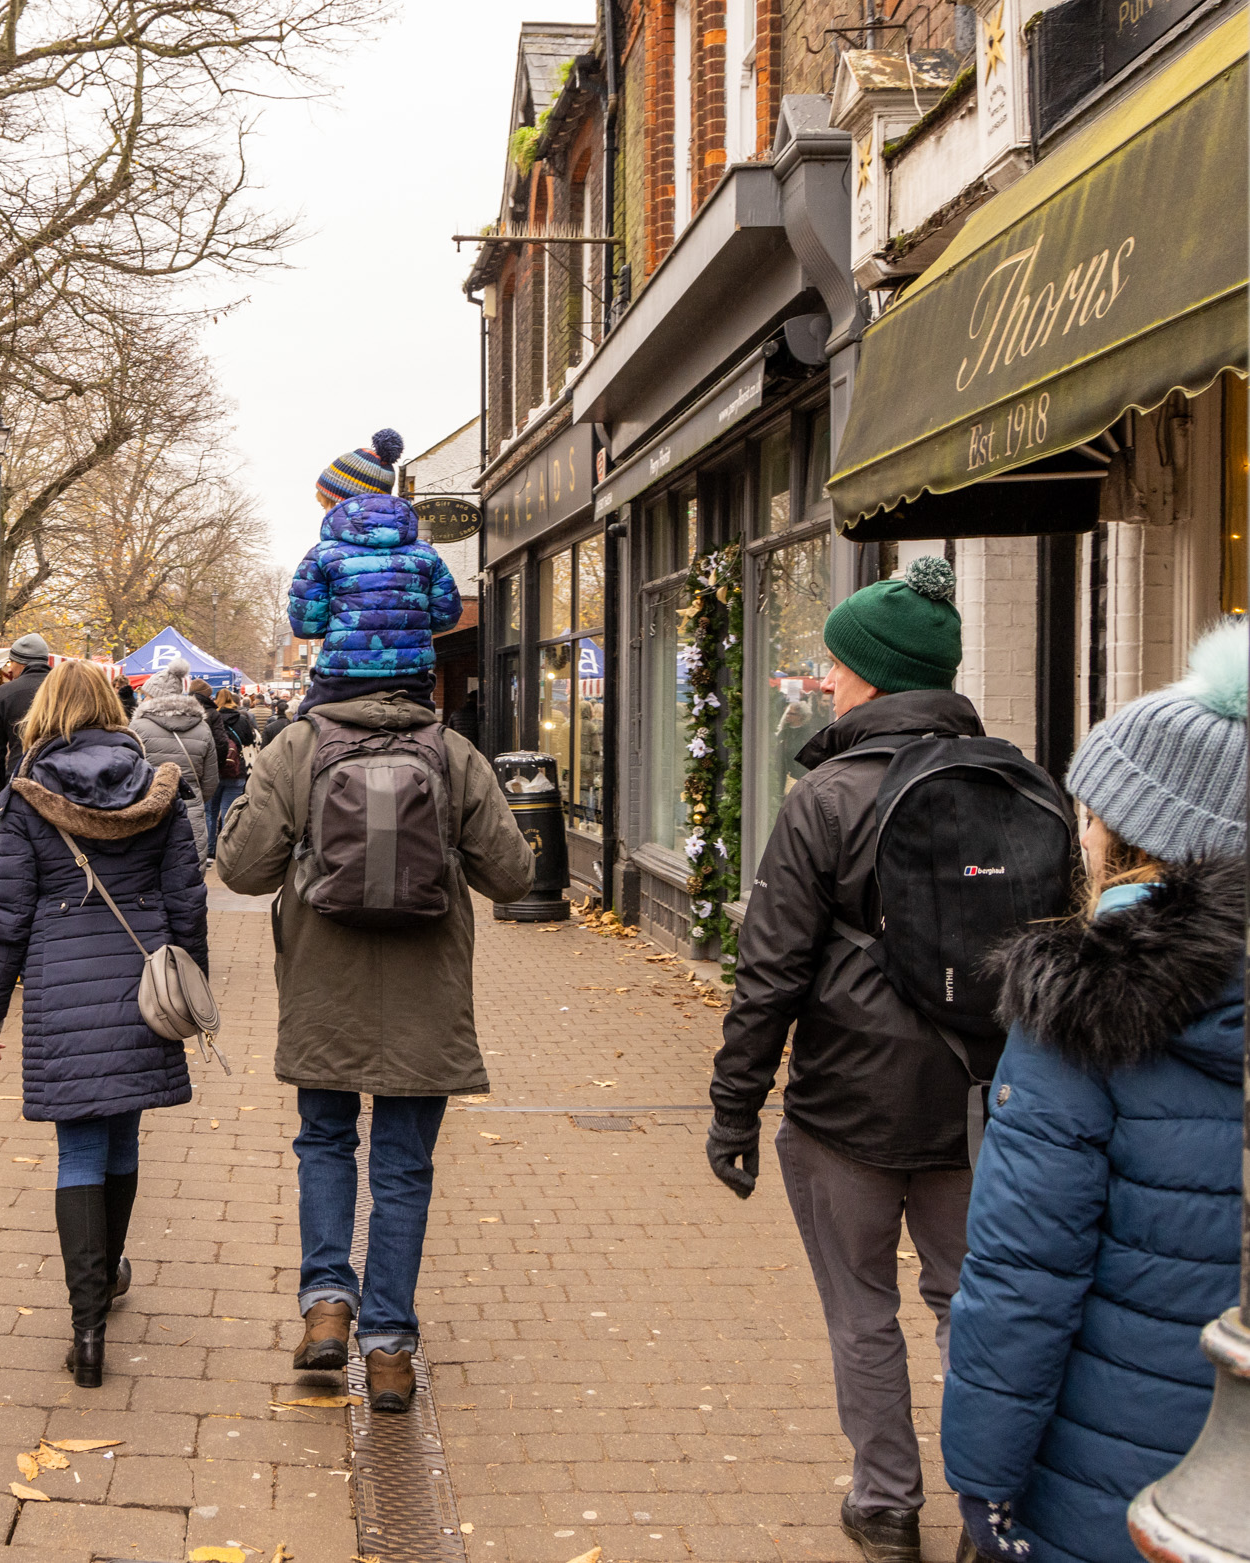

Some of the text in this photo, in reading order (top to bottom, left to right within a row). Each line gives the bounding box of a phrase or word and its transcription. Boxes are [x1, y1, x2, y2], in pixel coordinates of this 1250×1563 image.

[956, 233, 1135, 392] Thorns
[967, 392, 1050, 471] Est. 1918
[455, 503, 469, 511] and
[494, 446, 575, 542] THREADS
[418, 513, 478, 523] HREADS
[459, 525, 476, 536] Shop
[945, 967, 954, 1002] RHYTHM
